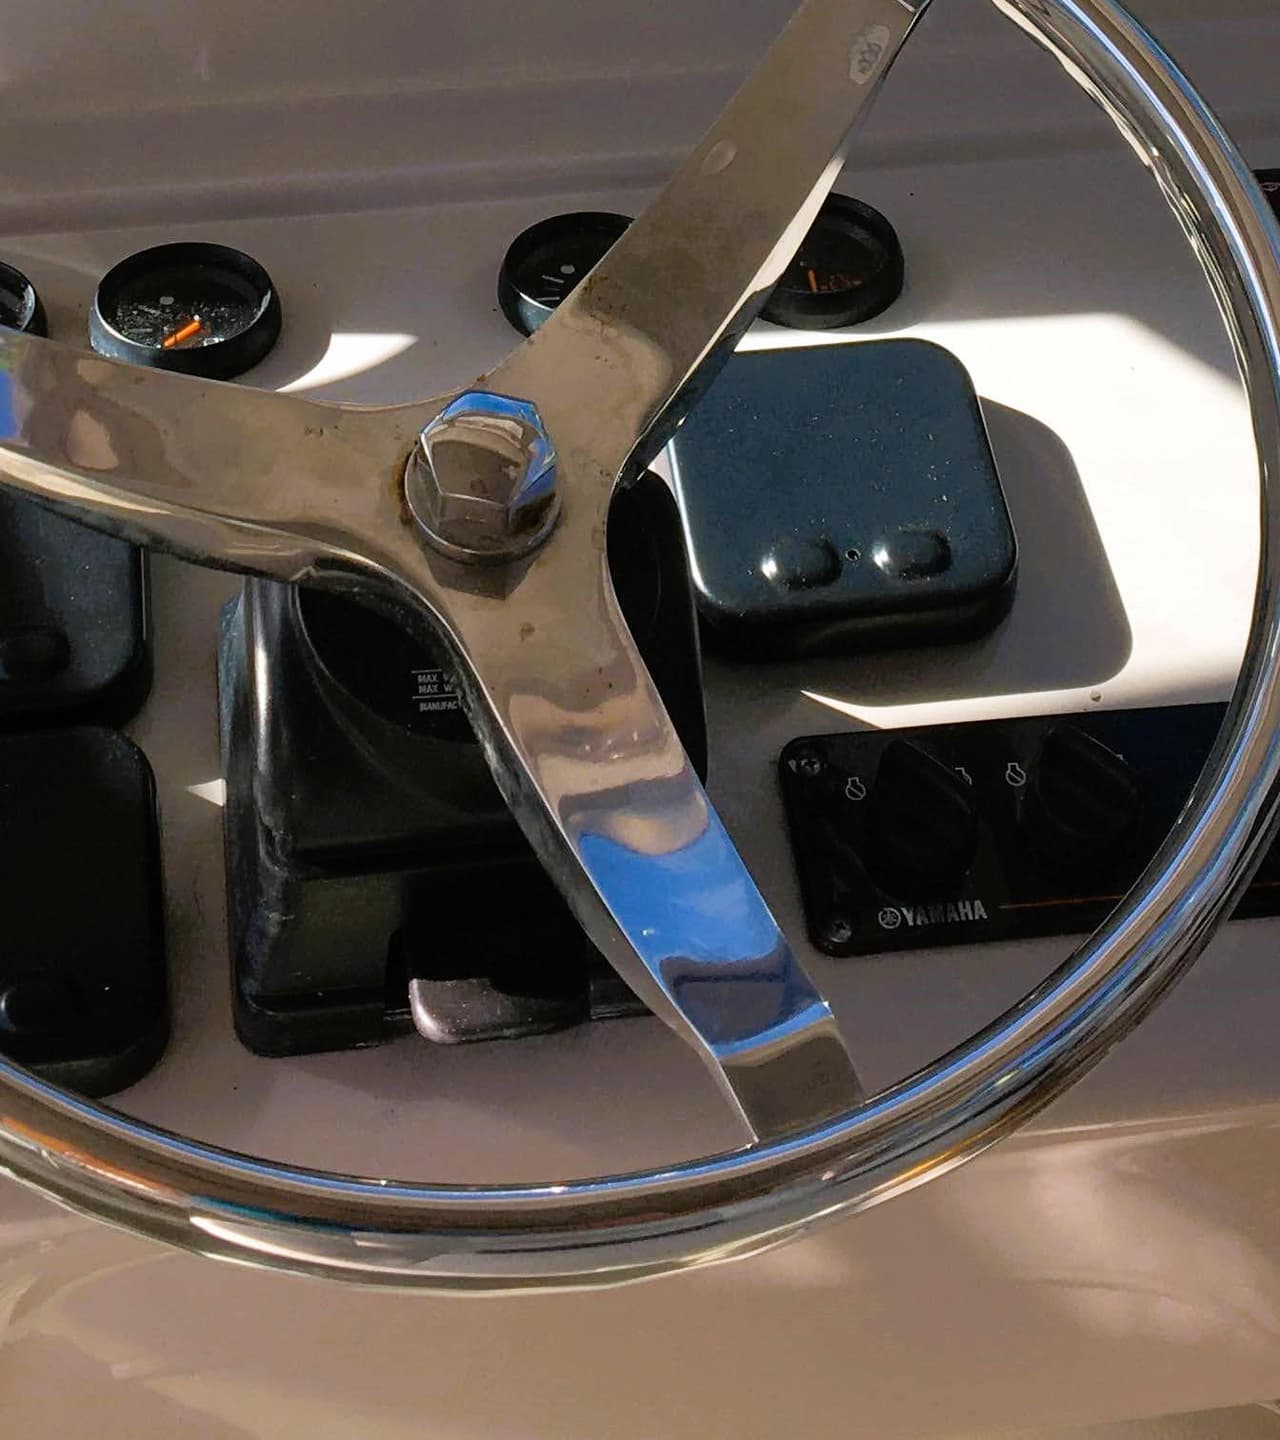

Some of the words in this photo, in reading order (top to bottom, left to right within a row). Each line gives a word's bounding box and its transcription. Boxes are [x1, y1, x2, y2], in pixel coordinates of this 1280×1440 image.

[417, 673, 439, 683] MAX
[418, 683, 439, 694] MAX
[901, 899, 987, 926] YAMAHA
